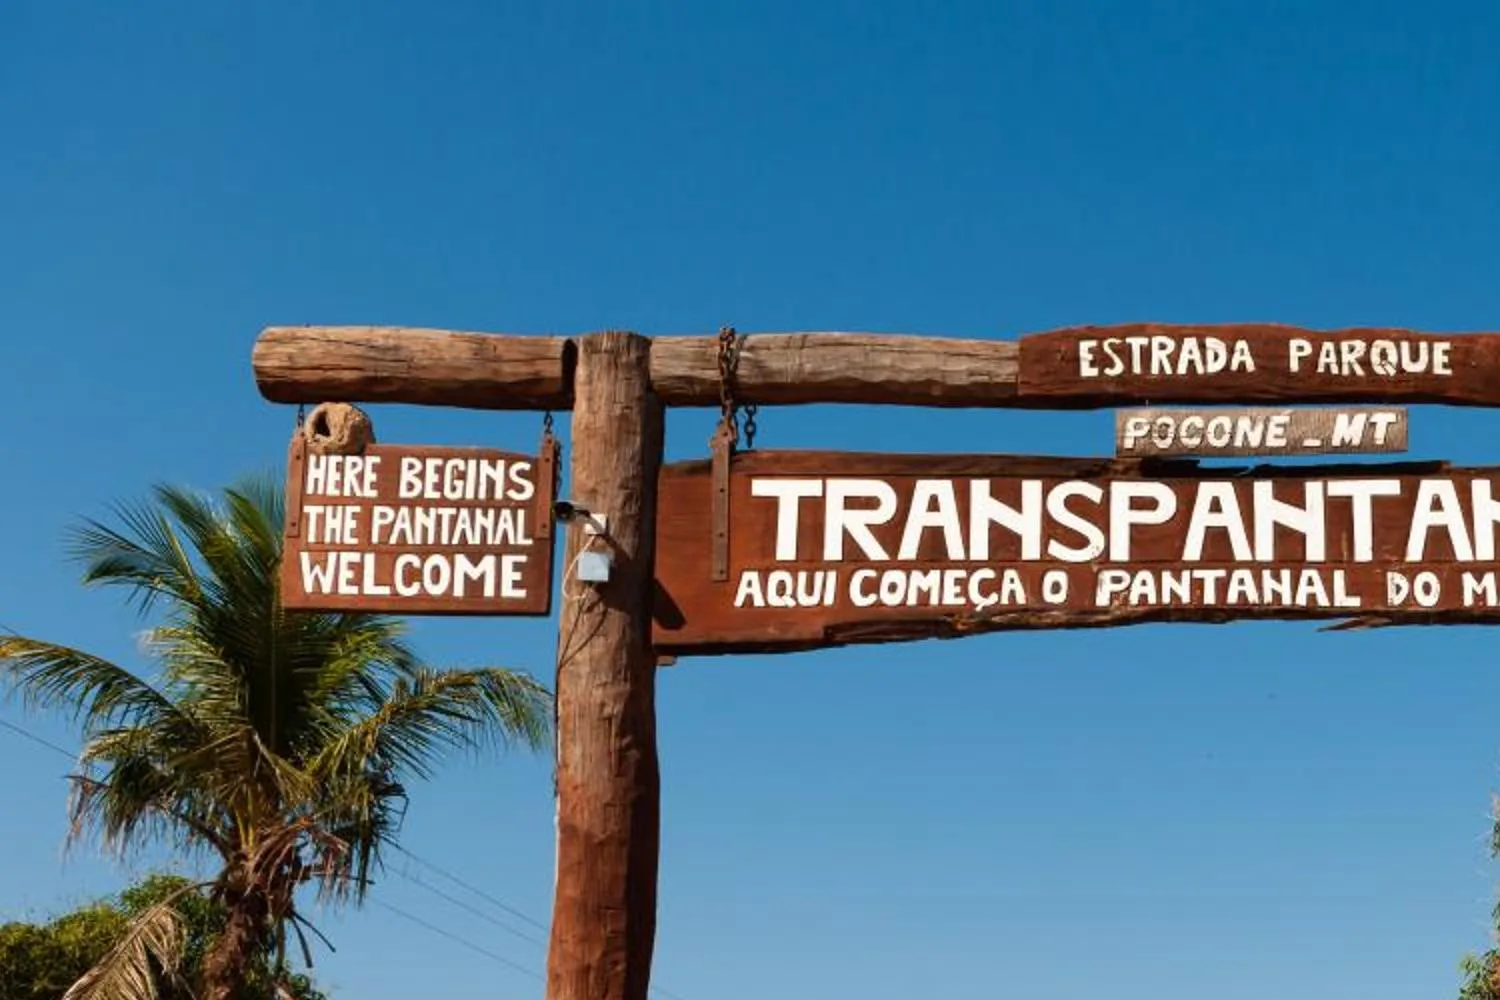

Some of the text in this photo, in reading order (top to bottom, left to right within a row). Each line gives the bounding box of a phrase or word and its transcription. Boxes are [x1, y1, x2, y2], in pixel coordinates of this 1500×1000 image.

[1078, 335, 1453, 378] ESTRADA PARQUE
[1331, 412, 1398, 447] MT
[305, 453, 535, 501] HERE BEGINS
[302, 504, 534, 546] THE PANTANAL
[299, 551, 528, 599] WELCOME
[733, 569, 837, 608] AQUI
[849, 567, 1027, 612] COMEÇA
[1042, 570, 1069, 605] O
[1095, 568, 1362, 607] PANTANAL
[1386, 571, 1441, 607] DO
